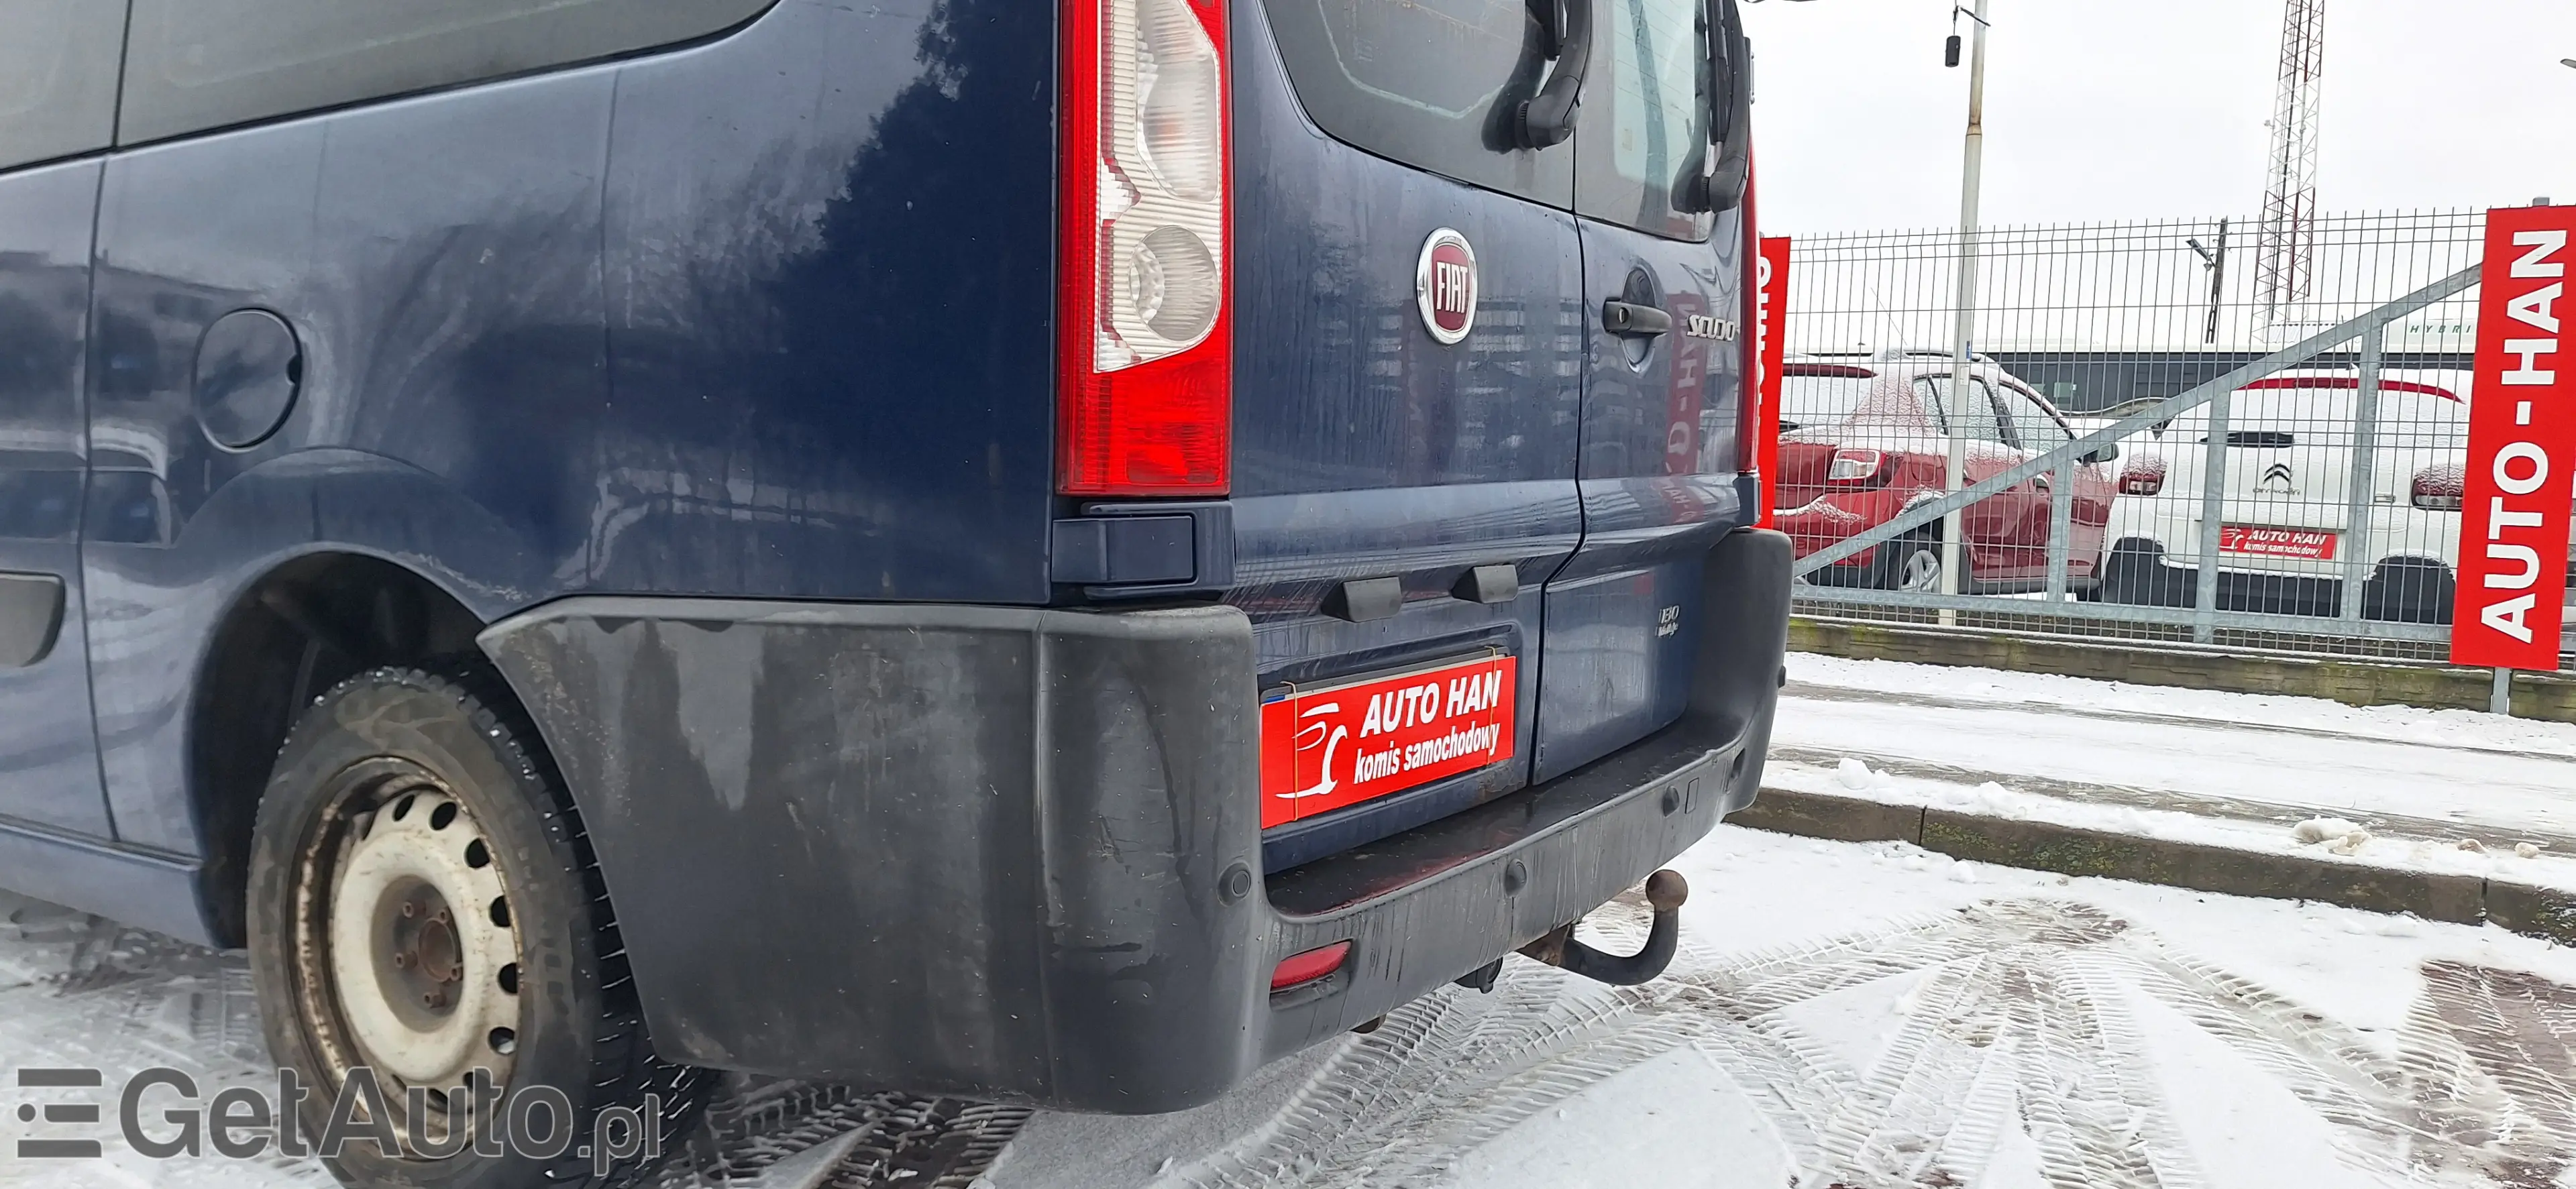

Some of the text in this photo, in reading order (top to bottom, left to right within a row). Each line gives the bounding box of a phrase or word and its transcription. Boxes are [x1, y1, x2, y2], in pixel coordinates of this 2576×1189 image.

[1436, 262, 1467, 313] FIAT
[1686, 315, 1735, 341] SCUDO
[2248, 530, 2326, 545] AUTO HAN
[1360, 669, 1503, 738] AUTO HAN
[1354, 721, 1501, 784] komis samochodowy
